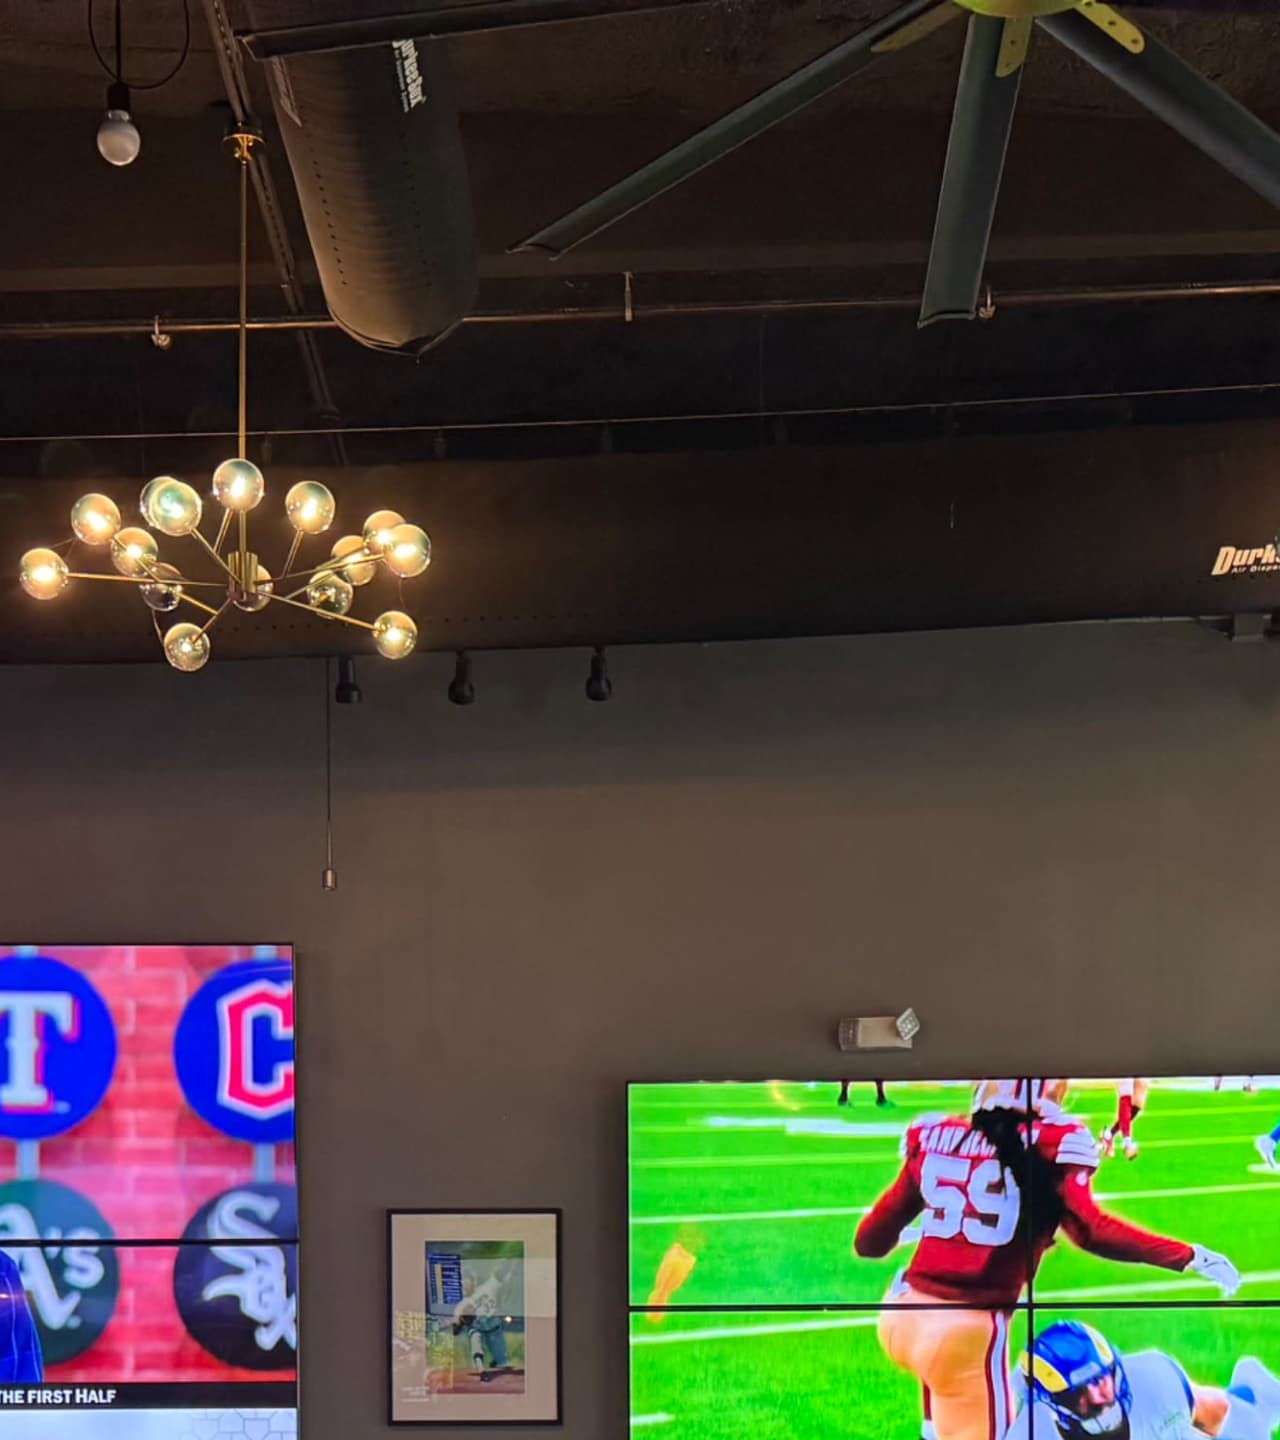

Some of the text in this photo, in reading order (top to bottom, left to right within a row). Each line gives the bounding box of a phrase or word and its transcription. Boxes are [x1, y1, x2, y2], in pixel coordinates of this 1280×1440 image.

[920, 1153, 1020, 1246] 59
[27, 1388, 73, 1403] FIRST
[75, 1388, 116, 1403] HALF
